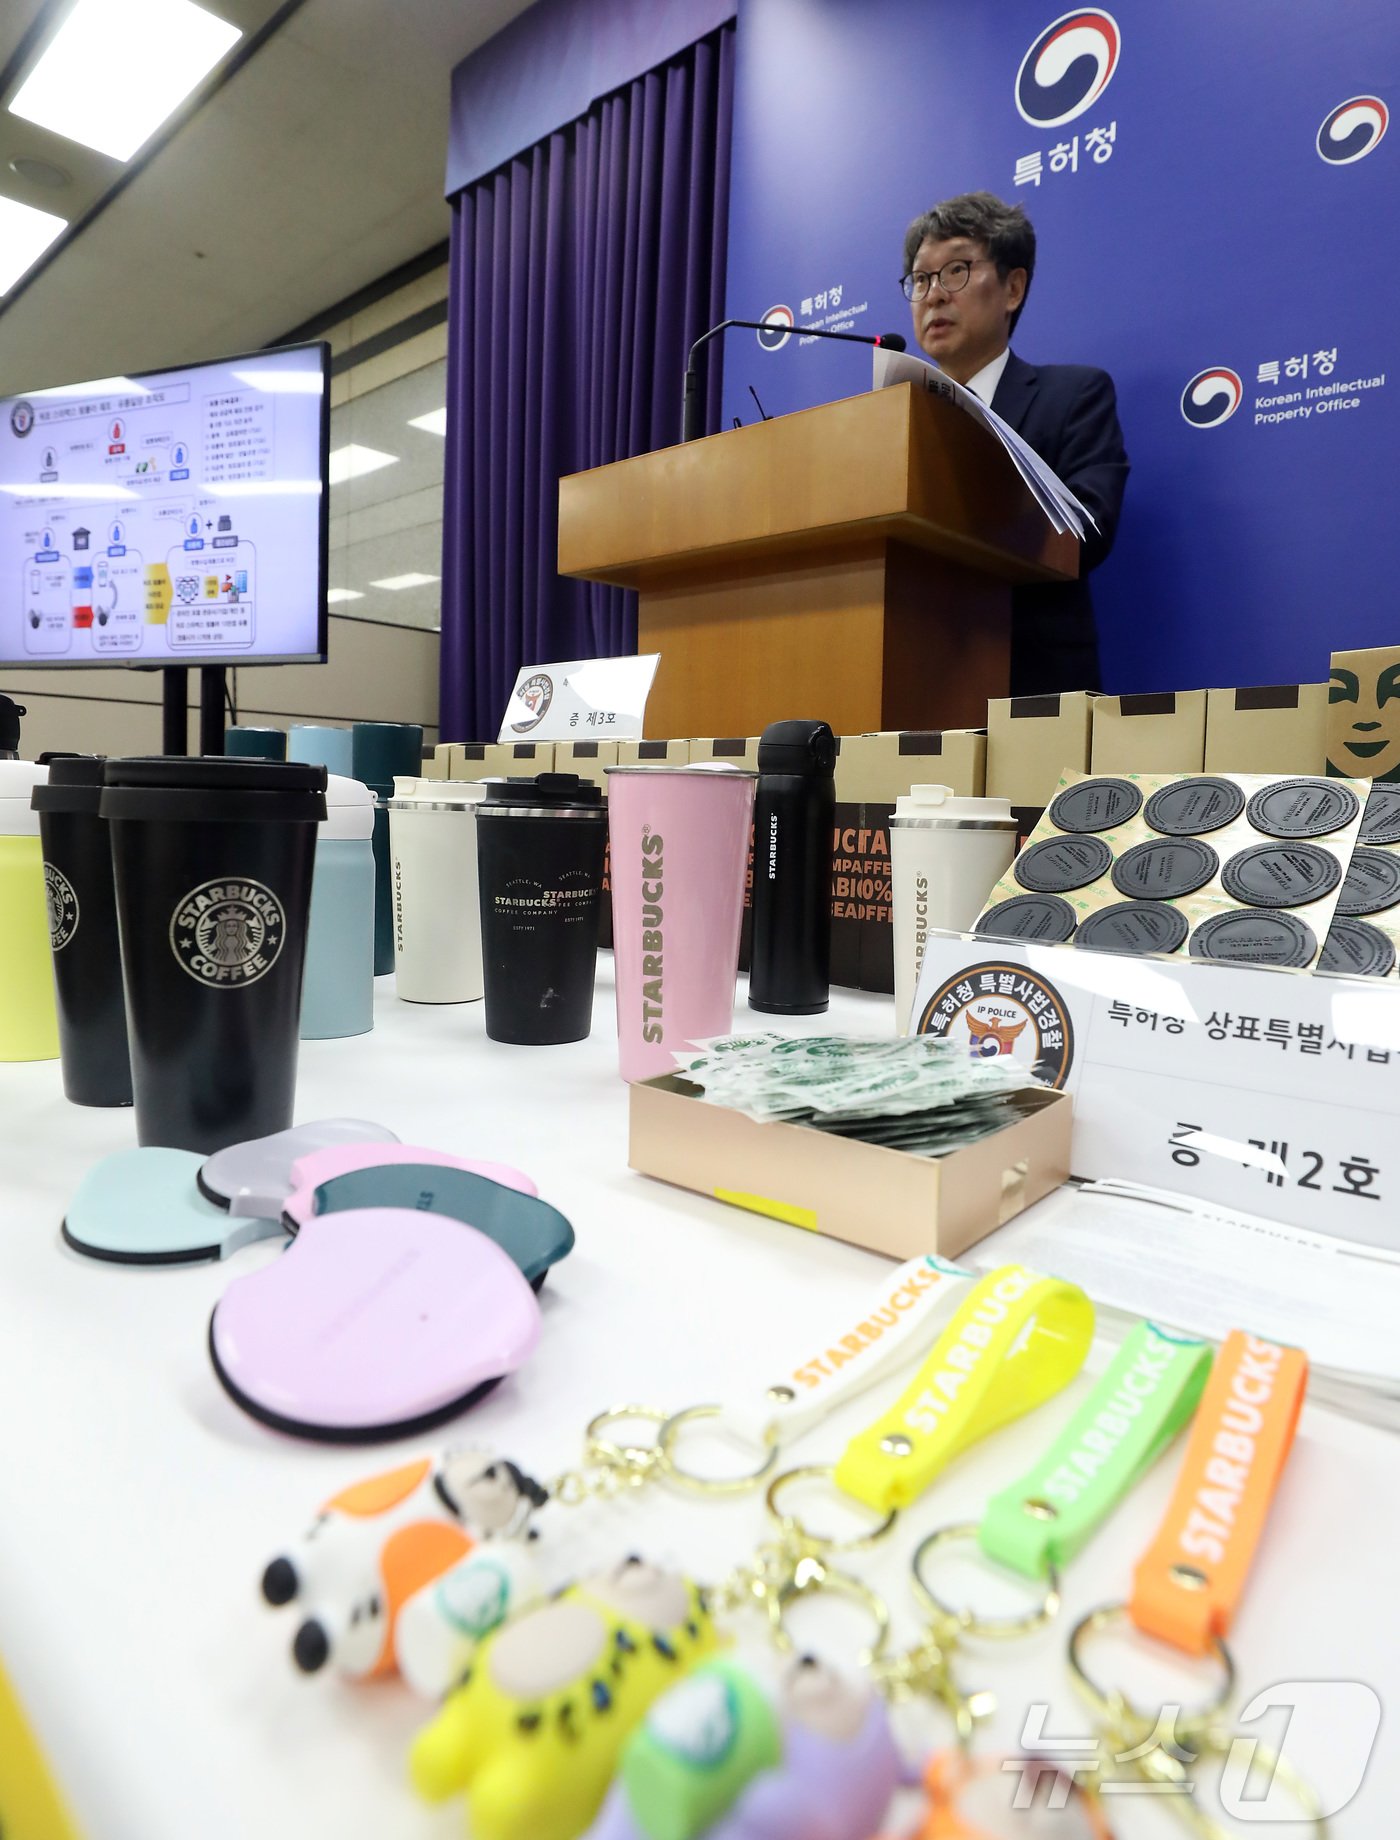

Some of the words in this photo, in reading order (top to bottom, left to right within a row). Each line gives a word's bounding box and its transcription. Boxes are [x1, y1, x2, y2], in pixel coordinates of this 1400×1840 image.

[1013, 121, 1116, 186] 특허청
[800, 285, 843, 316] 특허청
[830, 320, 855, 334] Office
[1256, 348, 1338, 385] 특허청
[1255, 391, 1302, 409] Korean
[1306, 374, 1386, 400] Intellectual
[1254, 405, 1313, 425] Property
[1316, 397, 1361, 414] Office
[569, 712, 579, 727] 증
[586, 711, 616, 726] 제3호
[178, 885, 280, 929] STARBUCKS
[190, 953, 267, 980] COFFEE
[931, 980, 975, 1031] 특허청
[979, 973, 1063, 1050] 특별사법경찰
[977, 1005, 986, 1013] IP
[987, 1006, 1017, 1018] POLICE
[1202, 1212, 1324, 1250] STARBUCKS
[792, 1268, 941, 1389] STARBUCKS
[1044, 1335, 1177, 1503] STARBUCKS
[1179, 1330, 1283, 1563] STARBUCKS
